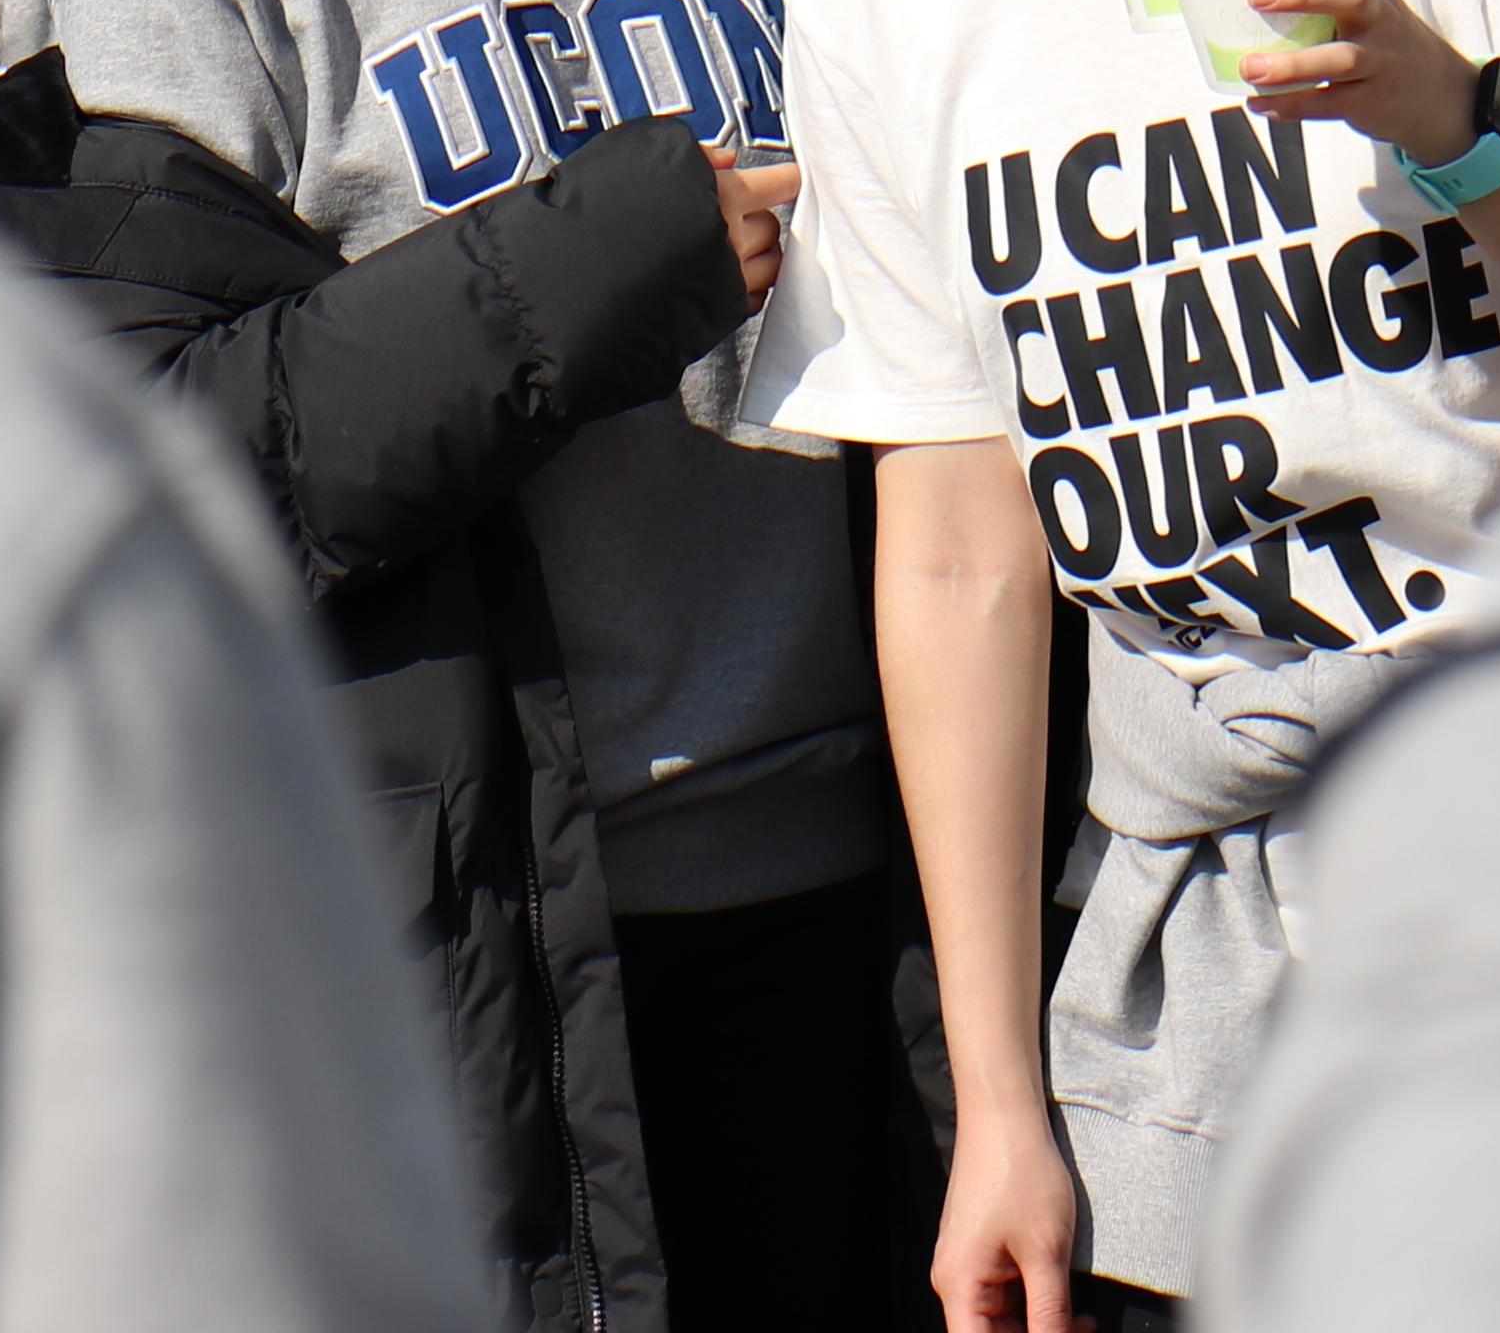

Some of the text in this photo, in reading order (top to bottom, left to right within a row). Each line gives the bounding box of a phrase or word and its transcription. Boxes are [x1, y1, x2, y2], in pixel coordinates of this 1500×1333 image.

[963, 104, 1318, 298] U CAN
[1028, 414, 1308, 581] OUR
